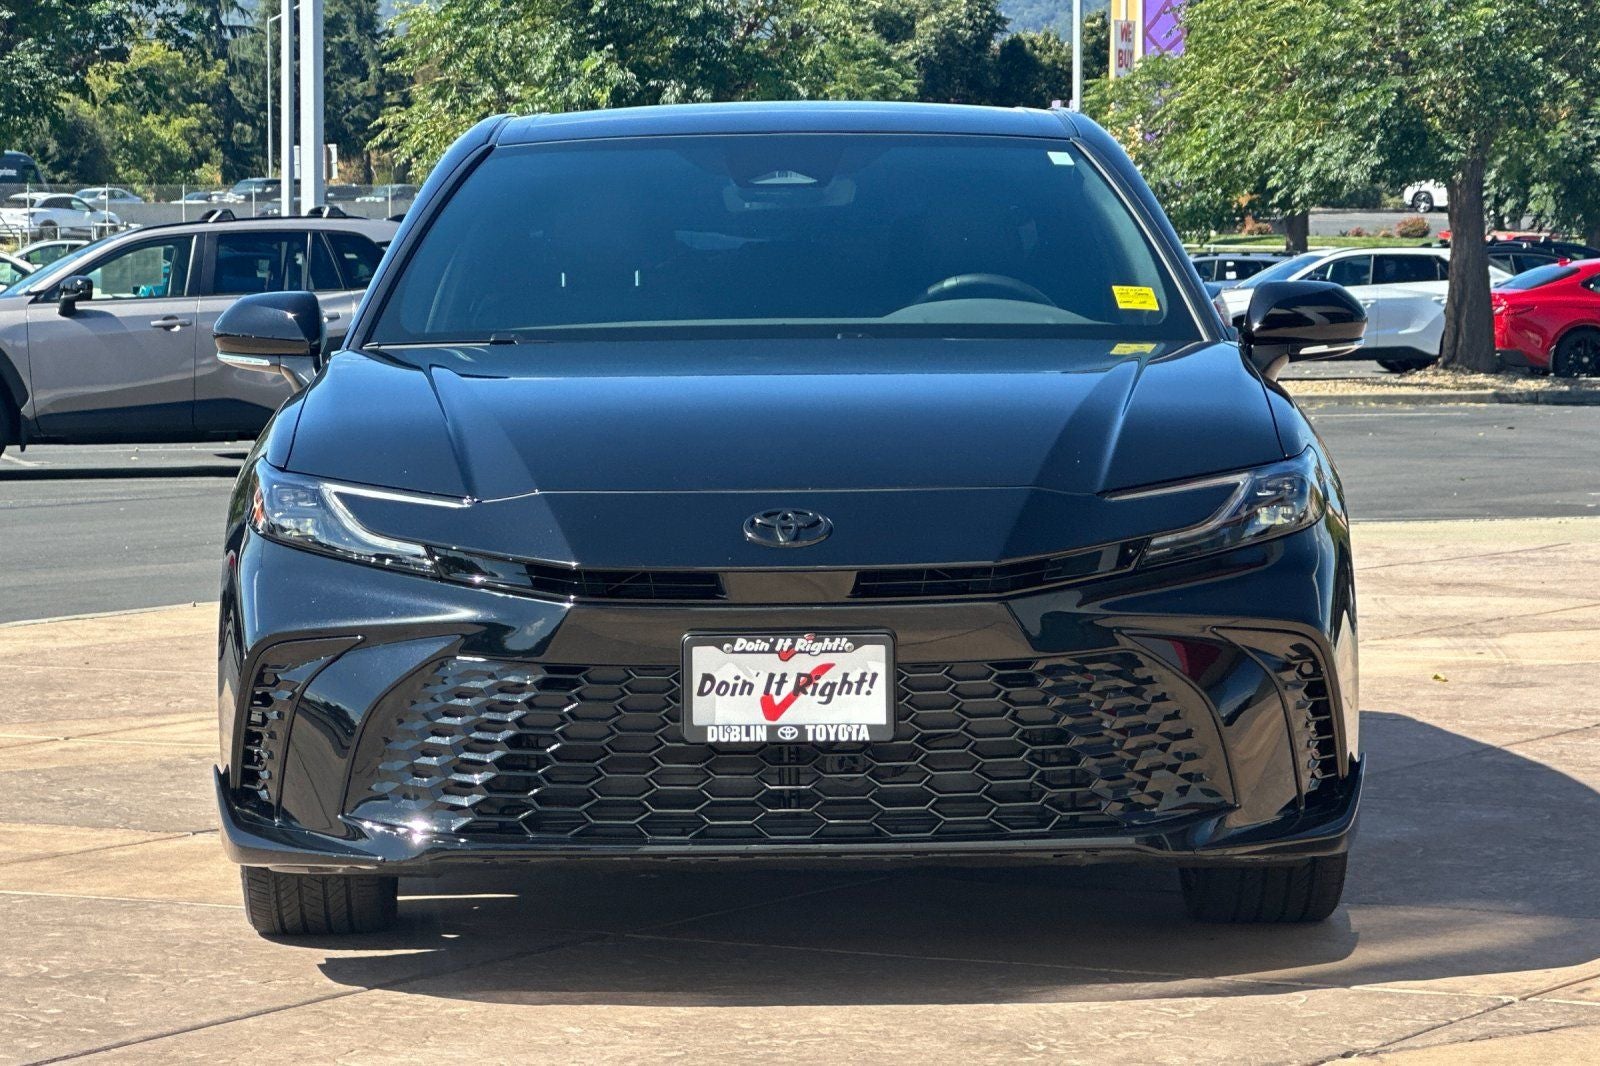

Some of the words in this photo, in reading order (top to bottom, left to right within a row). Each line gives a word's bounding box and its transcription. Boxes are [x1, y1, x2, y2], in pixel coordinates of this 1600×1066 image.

[1120, 22, 1132, 42] WE
[734, 637, 774, 652] Doin'
[775, 637, 793, 652] It
[794, 637, 847, 656] Right!
[696, 672, 760, 697] Doin'
[763, 672, 789, 697] It
[793, 672, 879, 705] Right!
[707, 725, 768, 742] DUBLIN
[805, 725, 870, 741] TOYOTA
